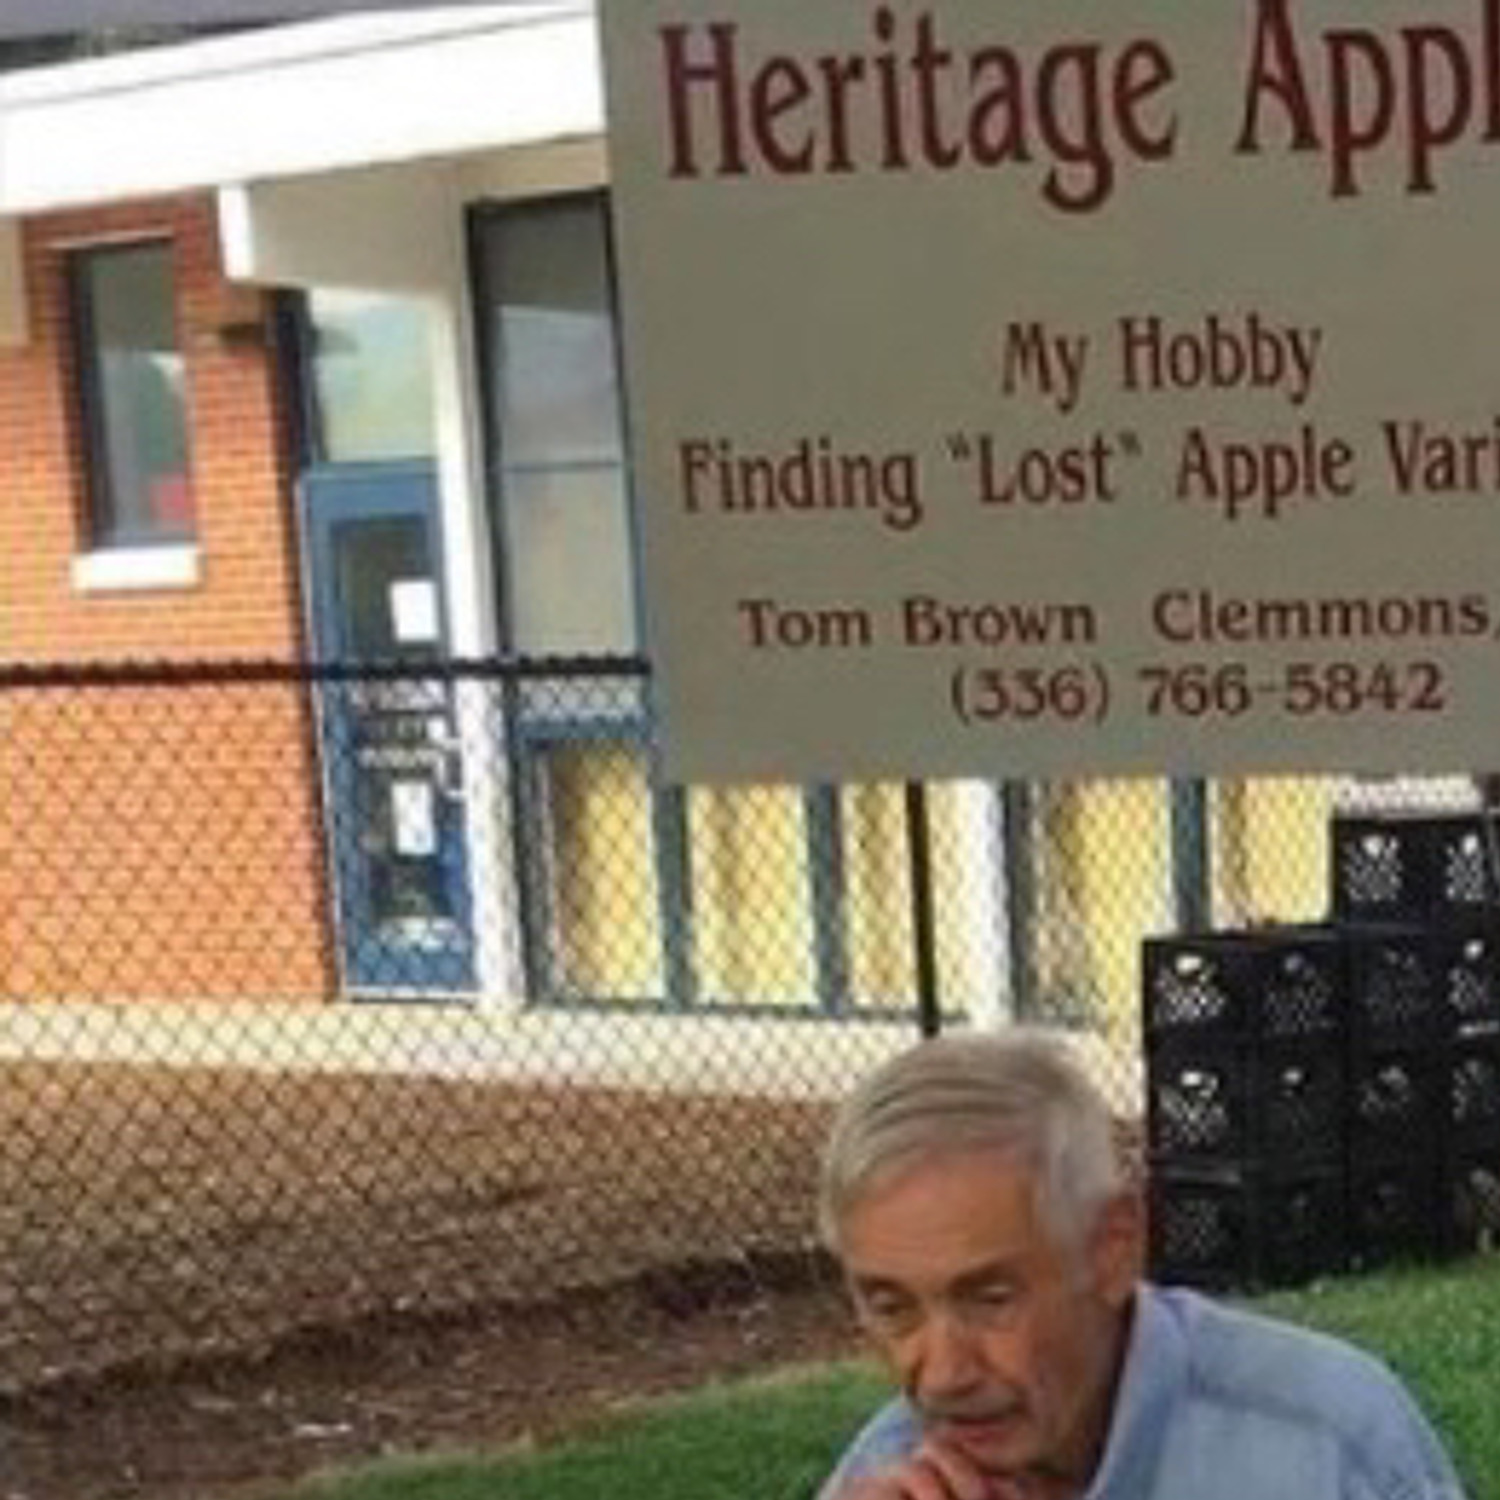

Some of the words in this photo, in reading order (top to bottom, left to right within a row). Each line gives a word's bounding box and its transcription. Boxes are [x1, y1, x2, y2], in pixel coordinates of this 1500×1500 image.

[661, 7, 1177, 213] Heritage
[1002, 321, 1090, 412] My
[1120, 313, 1323, 408] Hobby
[680, 437, 923, 530] Finding
[949, 430, 1143, 506] "Lost"
[1174, 428, 1354, 520] Apple
[739, 600, 873, 649] Tom
[904, 598, 1097, 647] Brown
[950, 663, 1111, 722] (336)
[1139, 660, 1446, 718] 766-5842
